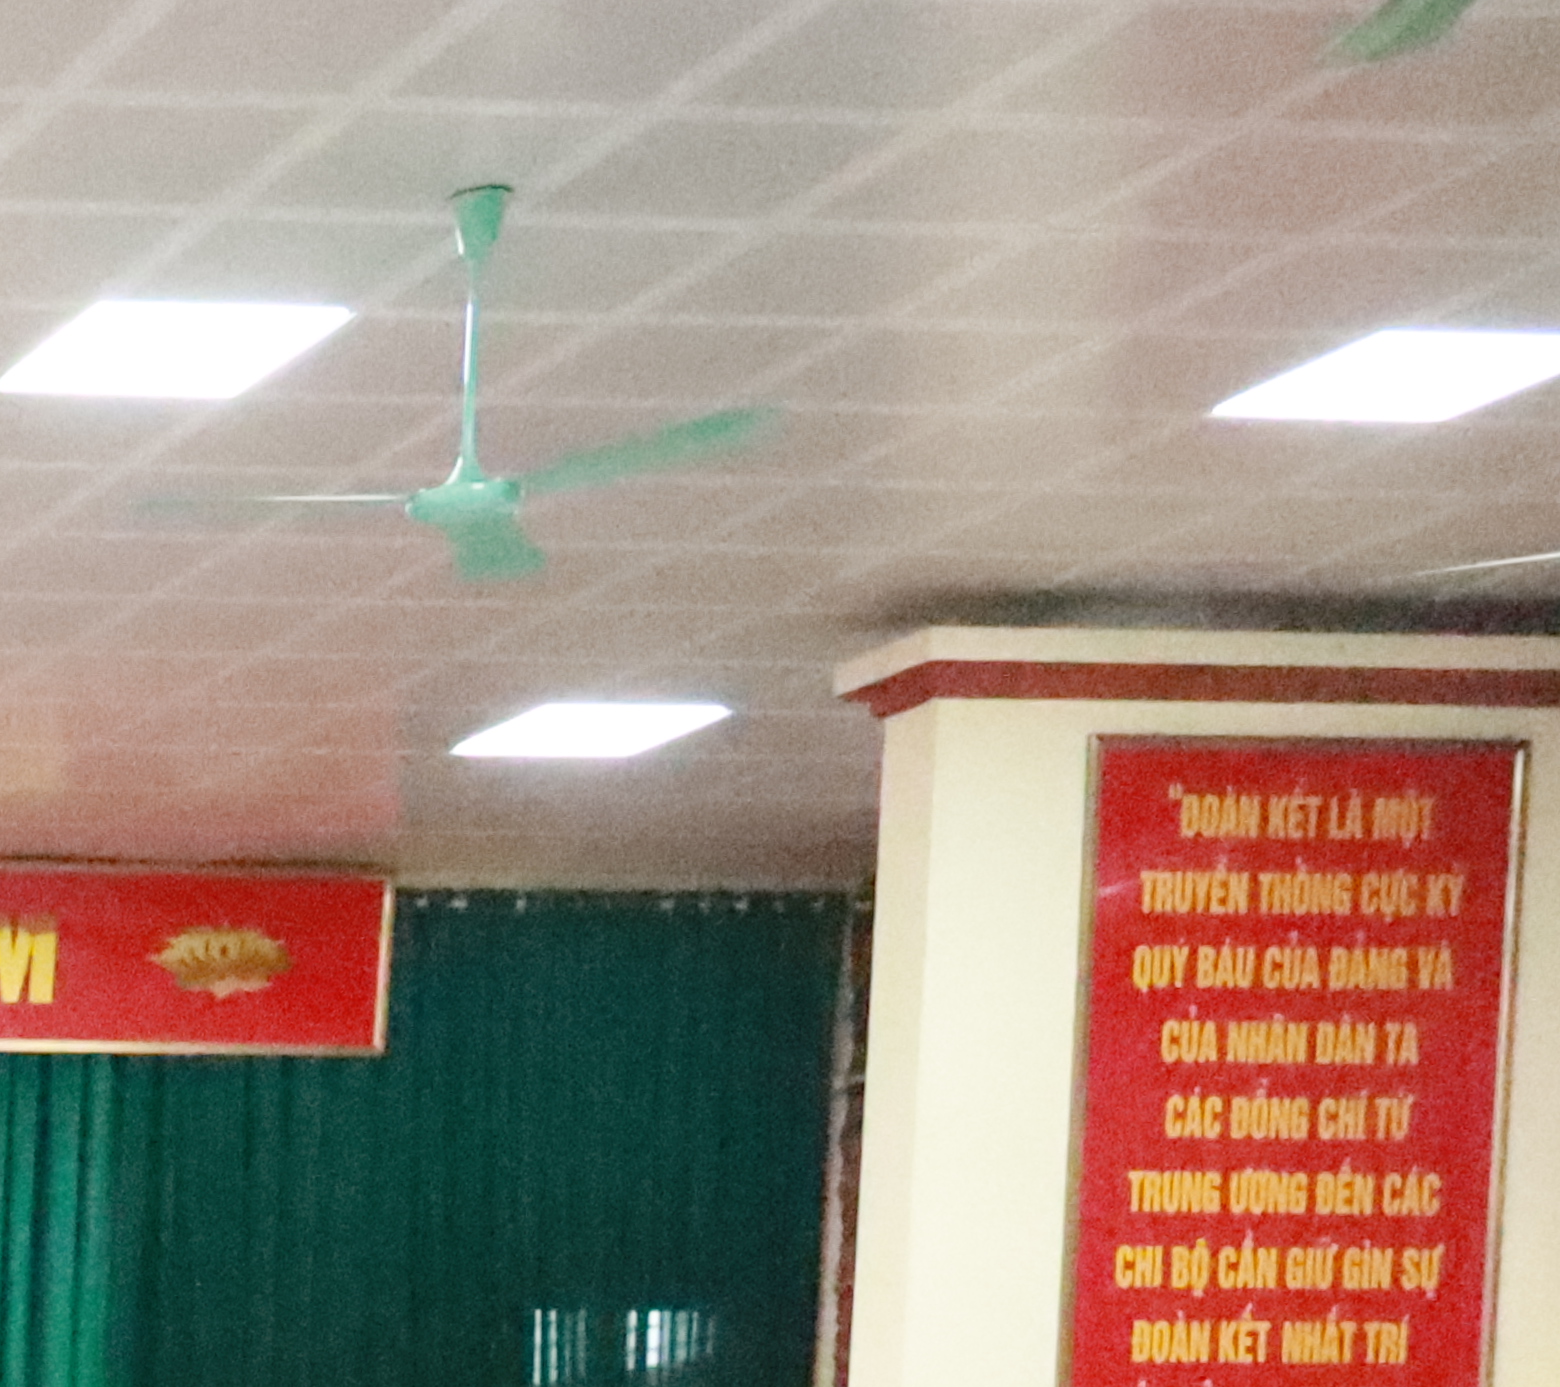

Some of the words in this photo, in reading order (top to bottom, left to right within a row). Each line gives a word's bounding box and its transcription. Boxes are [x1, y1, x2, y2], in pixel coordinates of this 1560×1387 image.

[1133, 938, 1189, 993] QUÝ
[1197, 936, 1255, 988] BÁU
[1262, 930, 1320, 988] CỦA
[1328, 930, 1408, 990] ĐẢNG
[1418, 940, 1453, 989] VÀ
[1161, 1005, 1217, 1063] CỦA
[1227, 1013, 1307, 1063] NHÂN
[1316, 1012, 1375, 1064] DÂN
[1385, 1022, 1419, 1064] TA
[1165, 1087, 1222, 1138] CÁC
[1230, 1079, 1309, 1138] ĐỒNG
[1318, 1090, 1368, 1139] CHÍ
[1128, 1170, 1220, 1213] TRUNG
[1230, 1169, 1308, 1214] ƯƠNG
[1316, 1158, 1374, 1215] ĐẾN
[1384, 1166, 1441, 1216] CÁC
[1115, 1245, 1162, 1288] CHI
[1172, 1239, 1209, 1296] BỘ
[1219, 1229, 1277, 1288] CẦN
[1286, 1238, 1339, 1289] GIỮ
[1343, 1240, 1393, 1290] GÌN
[1401, 1245, 1443, 1299] SỰ
[1132, 1311, 1209, 1362] ĐOÀN
[1219, 1304, 1271, 1362] KẾT
[1282, 1305, 1356, 1363] NHẤT
[1366, 1316, 1409, 1364] TRÍ
